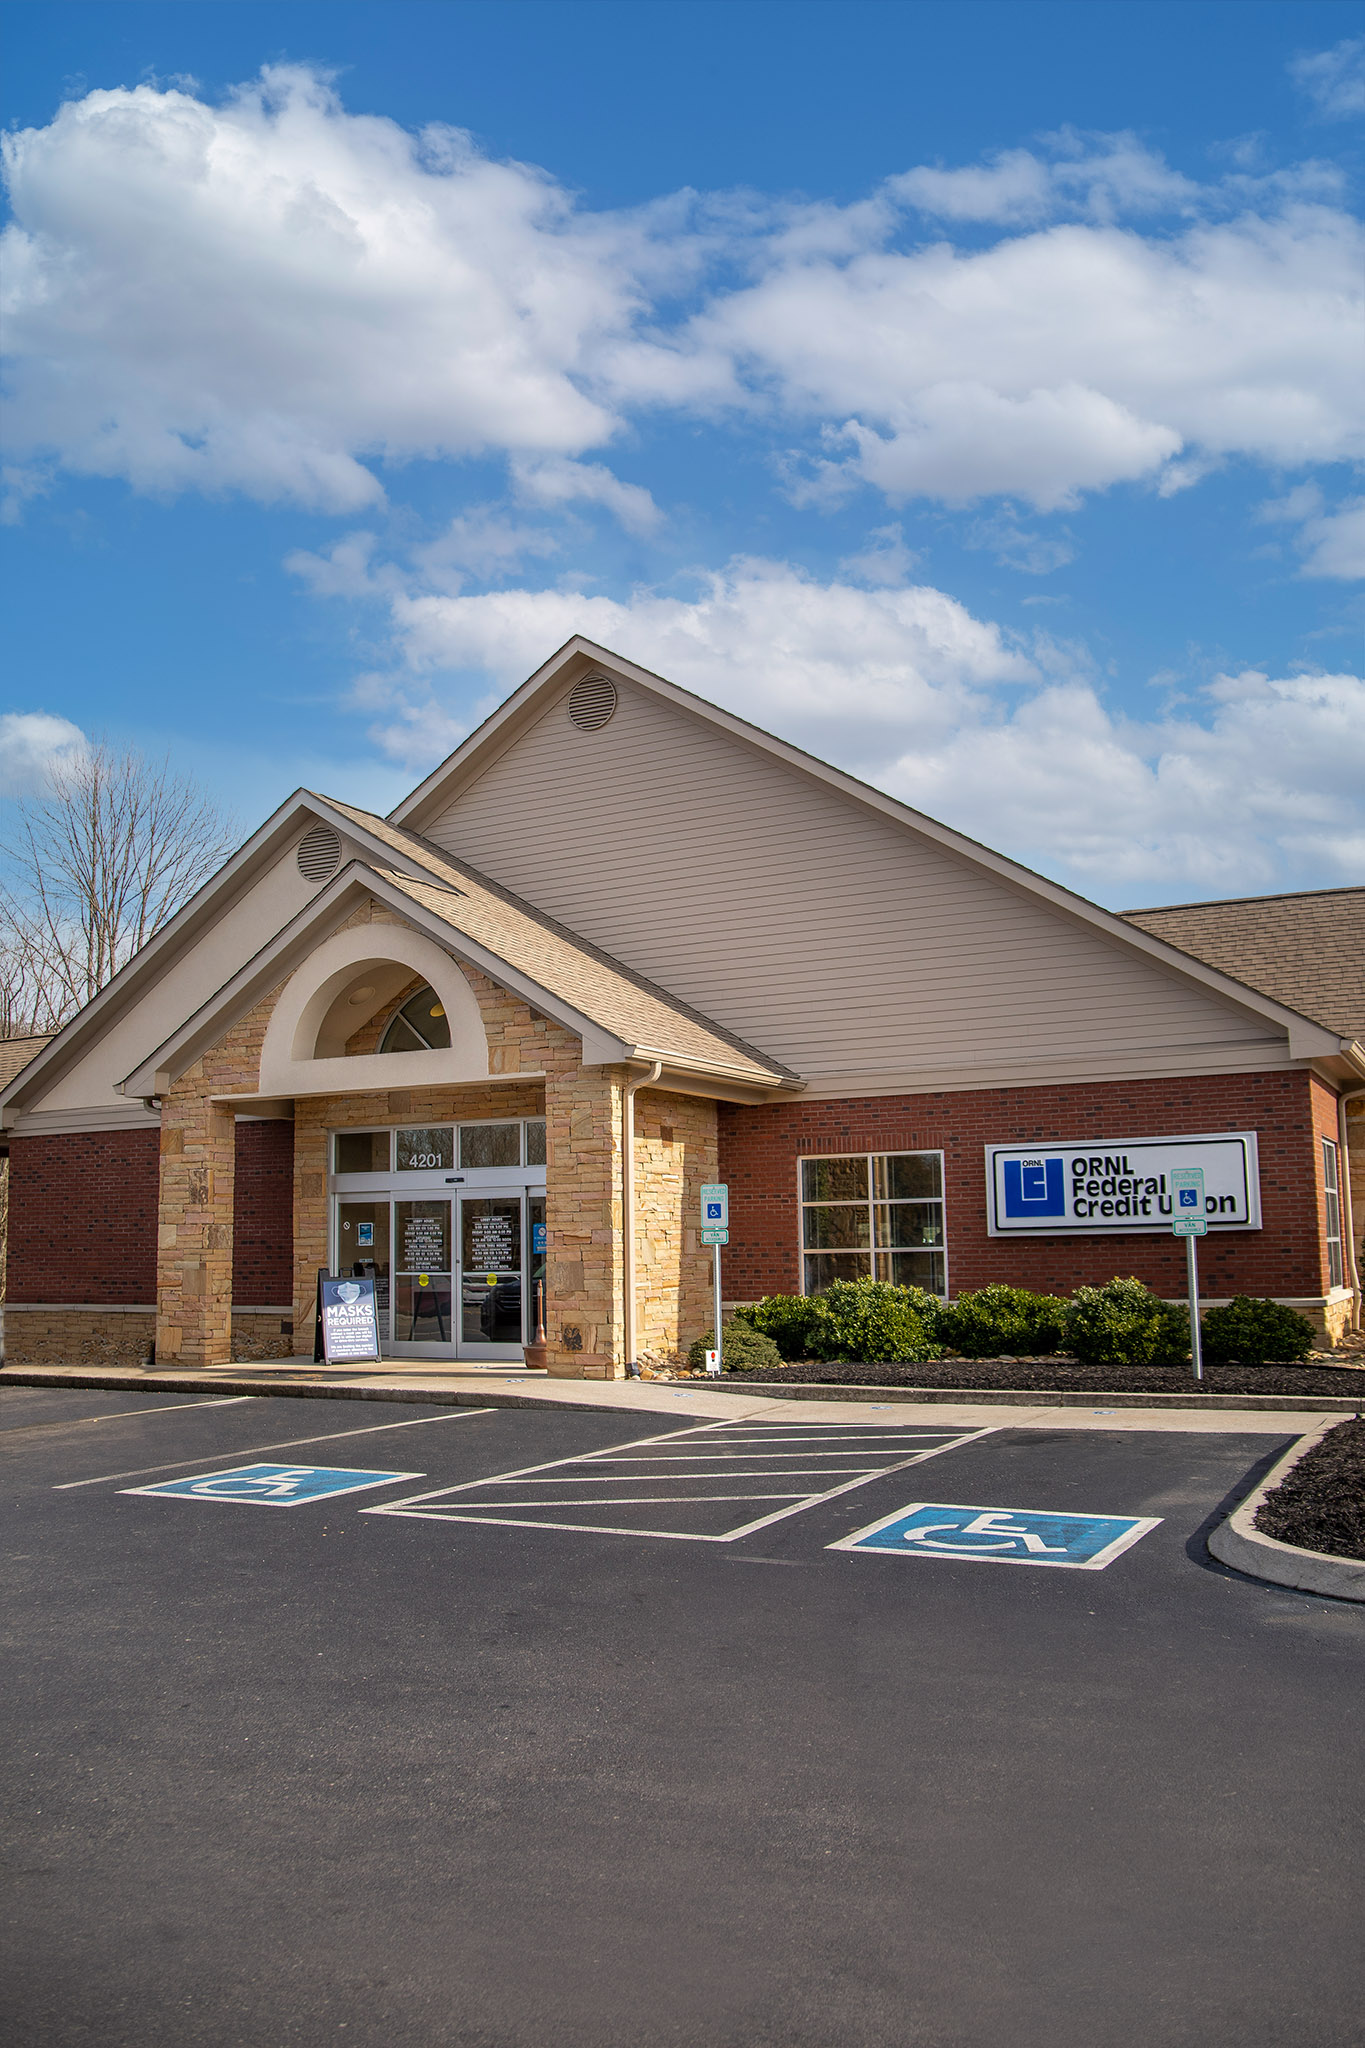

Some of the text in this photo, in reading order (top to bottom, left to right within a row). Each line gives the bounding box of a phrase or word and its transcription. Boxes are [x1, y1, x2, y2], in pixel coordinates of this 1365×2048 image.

[409, 1153, 442, 1168] 4201
[1022, 1159, 1044, 1167] ORNL
[1071, 1155, 1135, 1177] ORNL
[1072, 1174, 1166, 1197] Federal
[1073, 1194, 1237, 1217] Credit Uon
[327, 1305, 373, 1317] MASKS
[327, 1316, 374, 1326] REQUIRED
